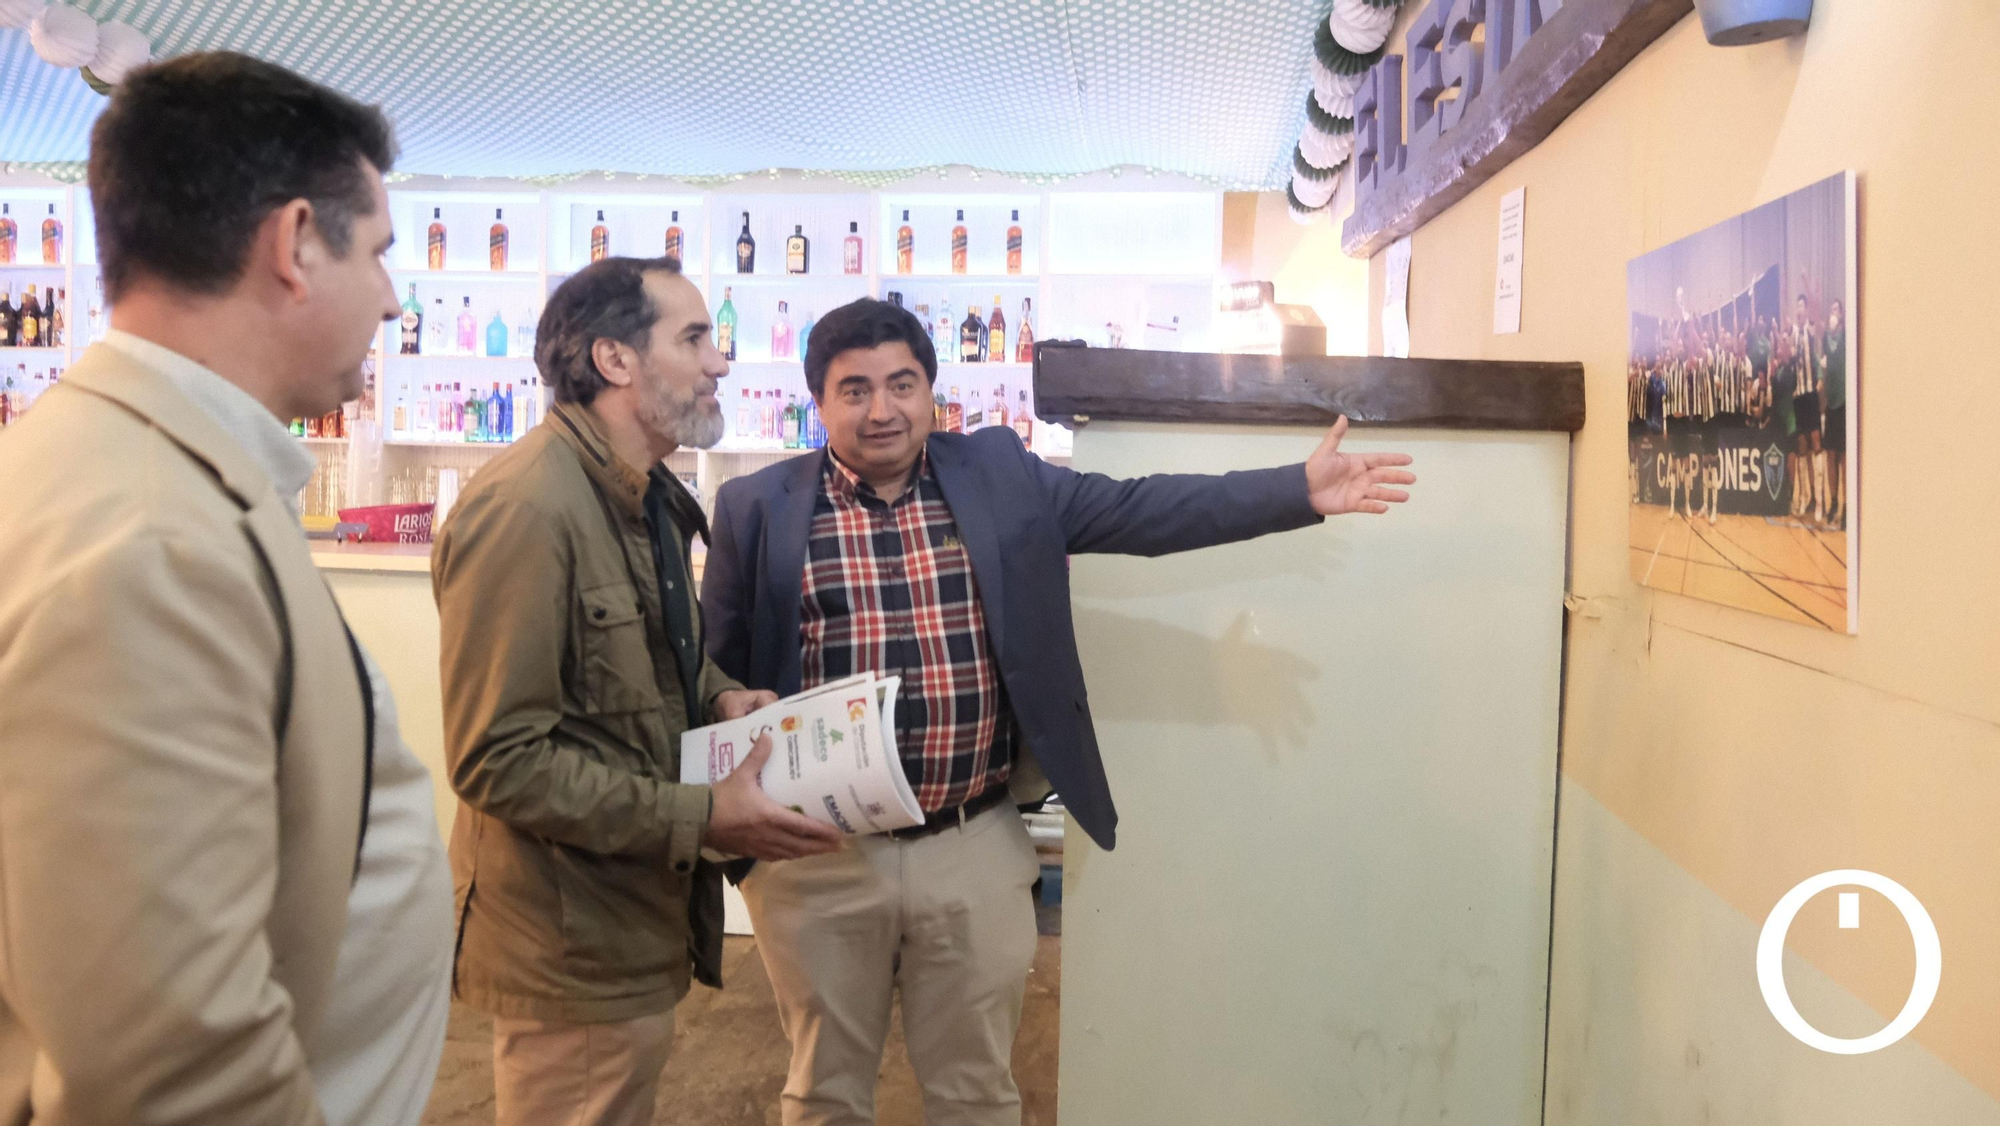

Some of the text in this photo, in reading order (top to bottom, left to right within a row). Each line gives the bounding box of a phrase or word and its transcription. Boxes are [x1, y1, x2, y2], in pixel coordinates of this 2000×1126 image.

[1354, 54, 1407, 190] EL
[394, 511, 433, 533] LARIOS
[816, 717, 828, 762] sadeco
